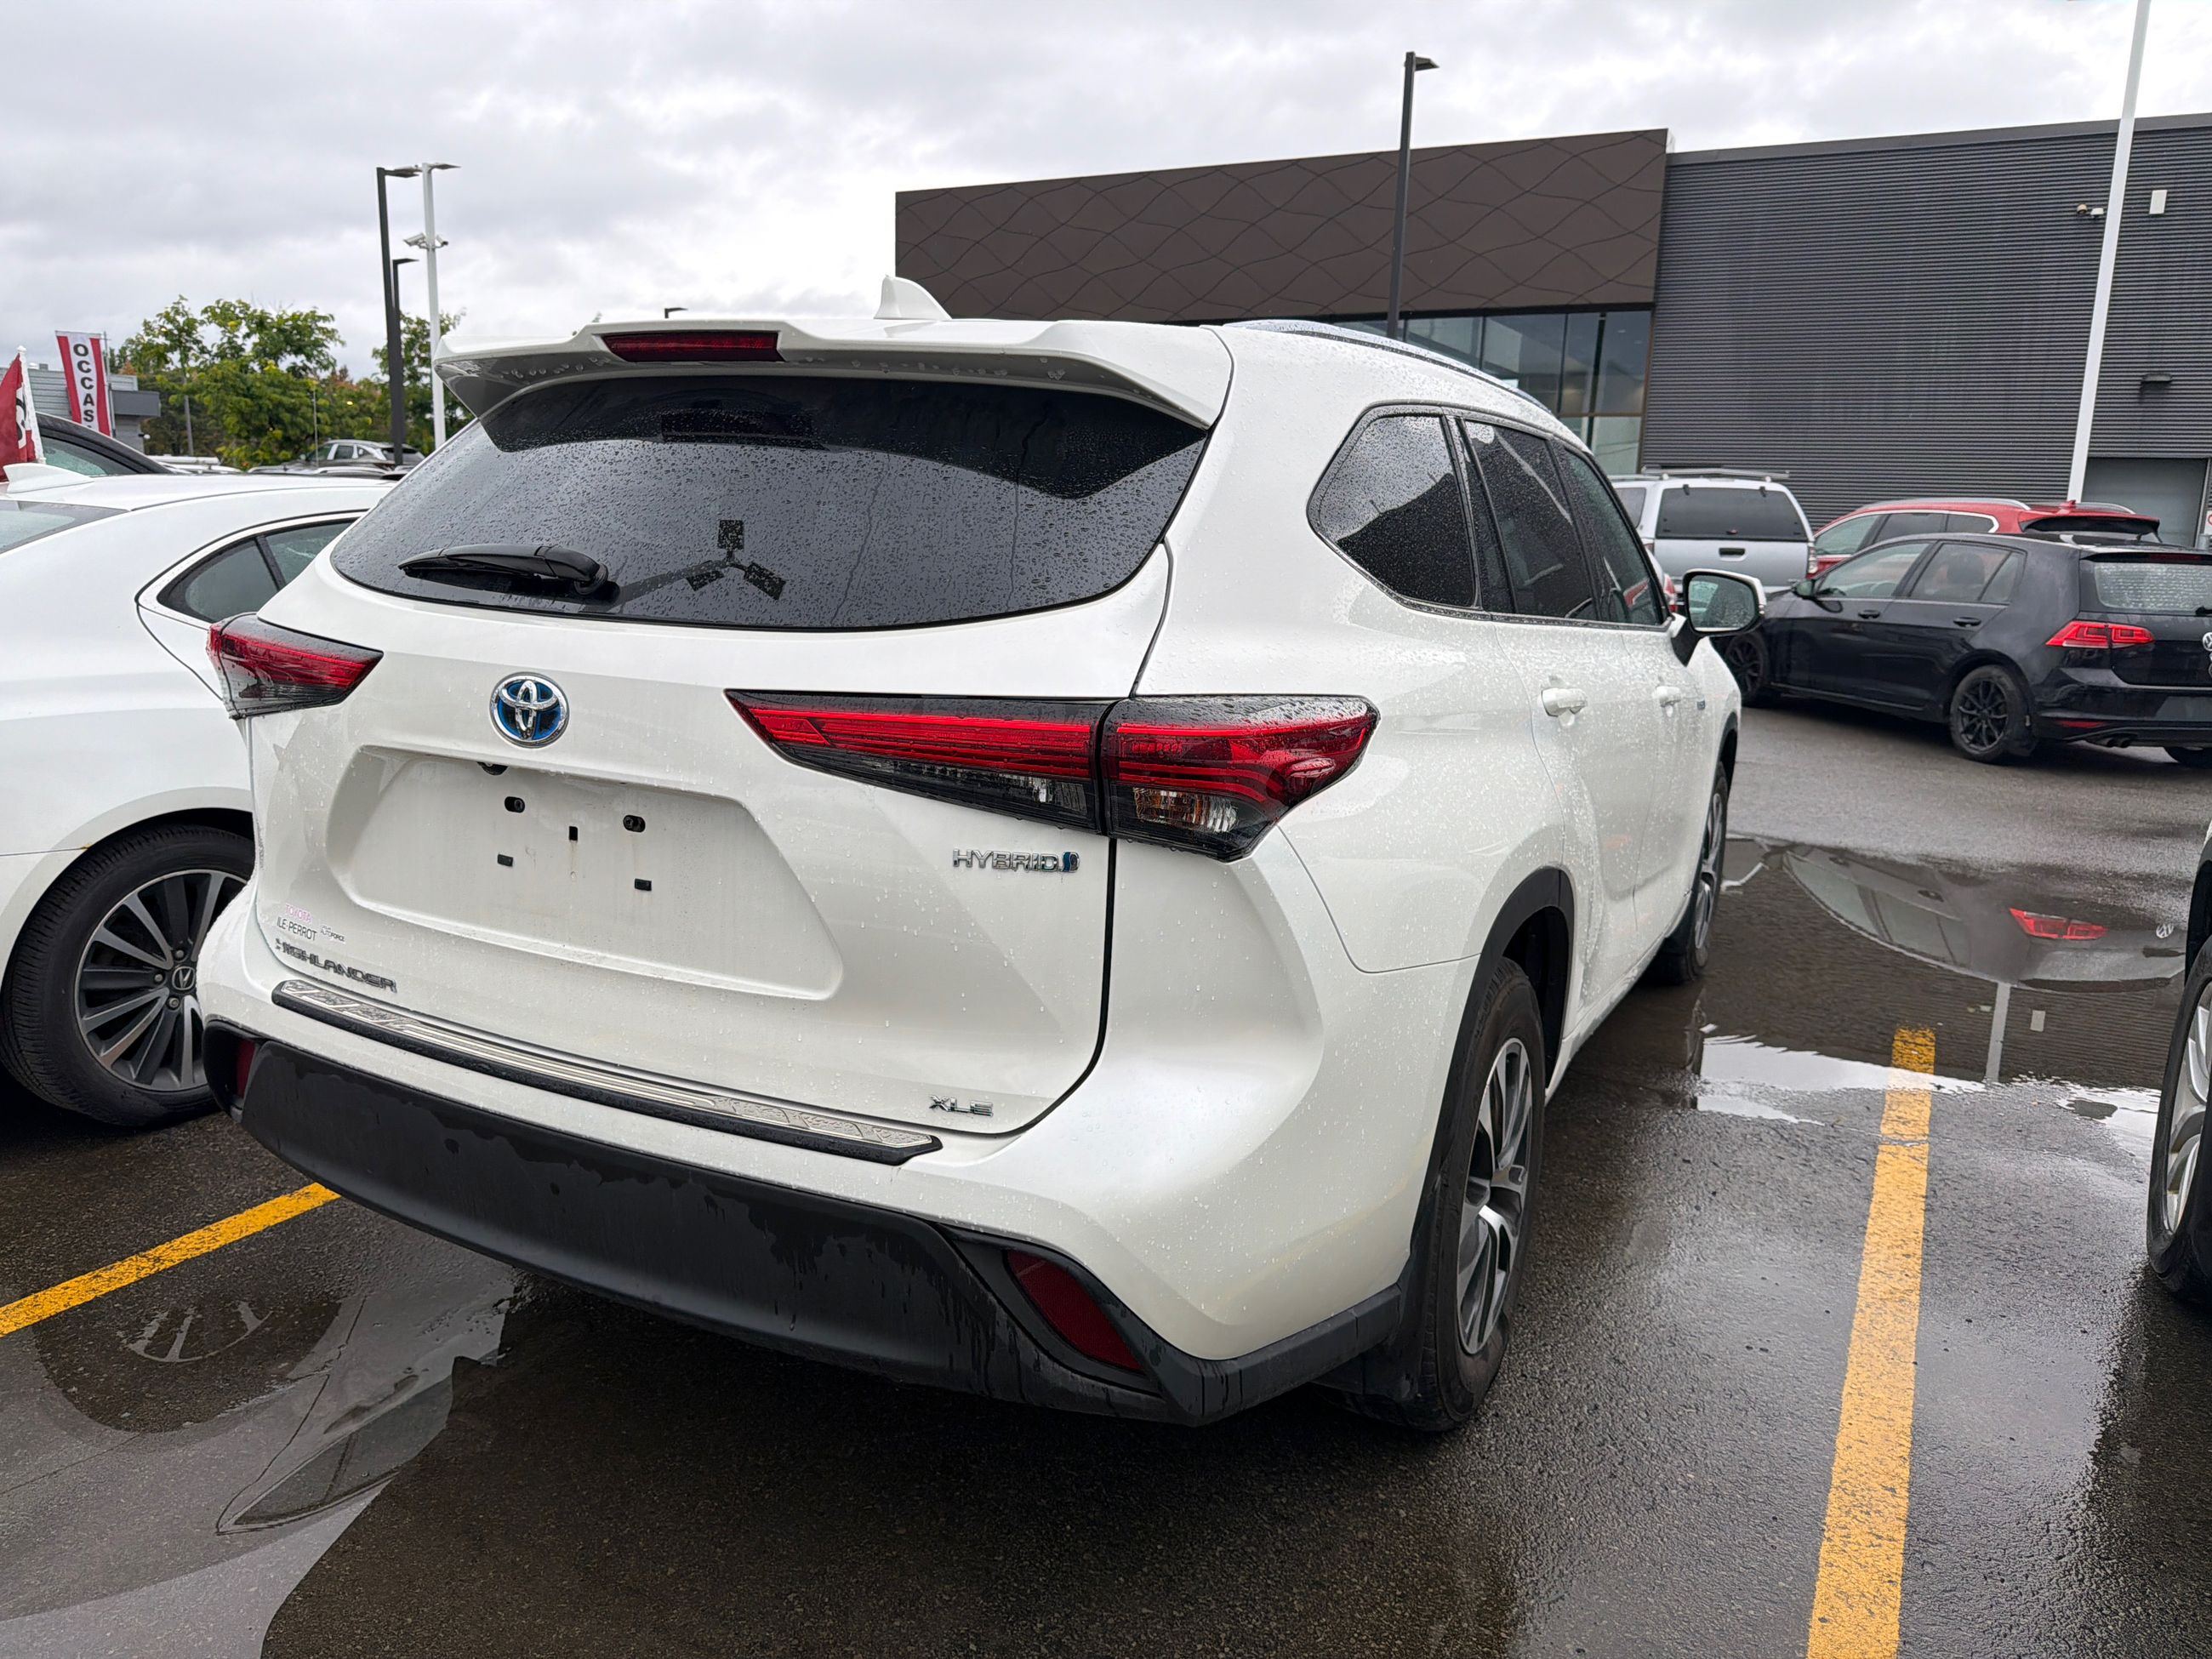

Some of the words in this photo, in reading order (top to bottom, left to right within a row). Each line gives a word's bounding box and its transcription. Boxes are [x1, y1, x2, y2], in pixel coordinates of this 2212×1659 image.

[73, 344, 95, 428] OCCAS
[952, 848, 1058, 872] HYBRID
[285, 904, 313, 923] TOYOTA
[928, 1094, 994, 1117] XLE
